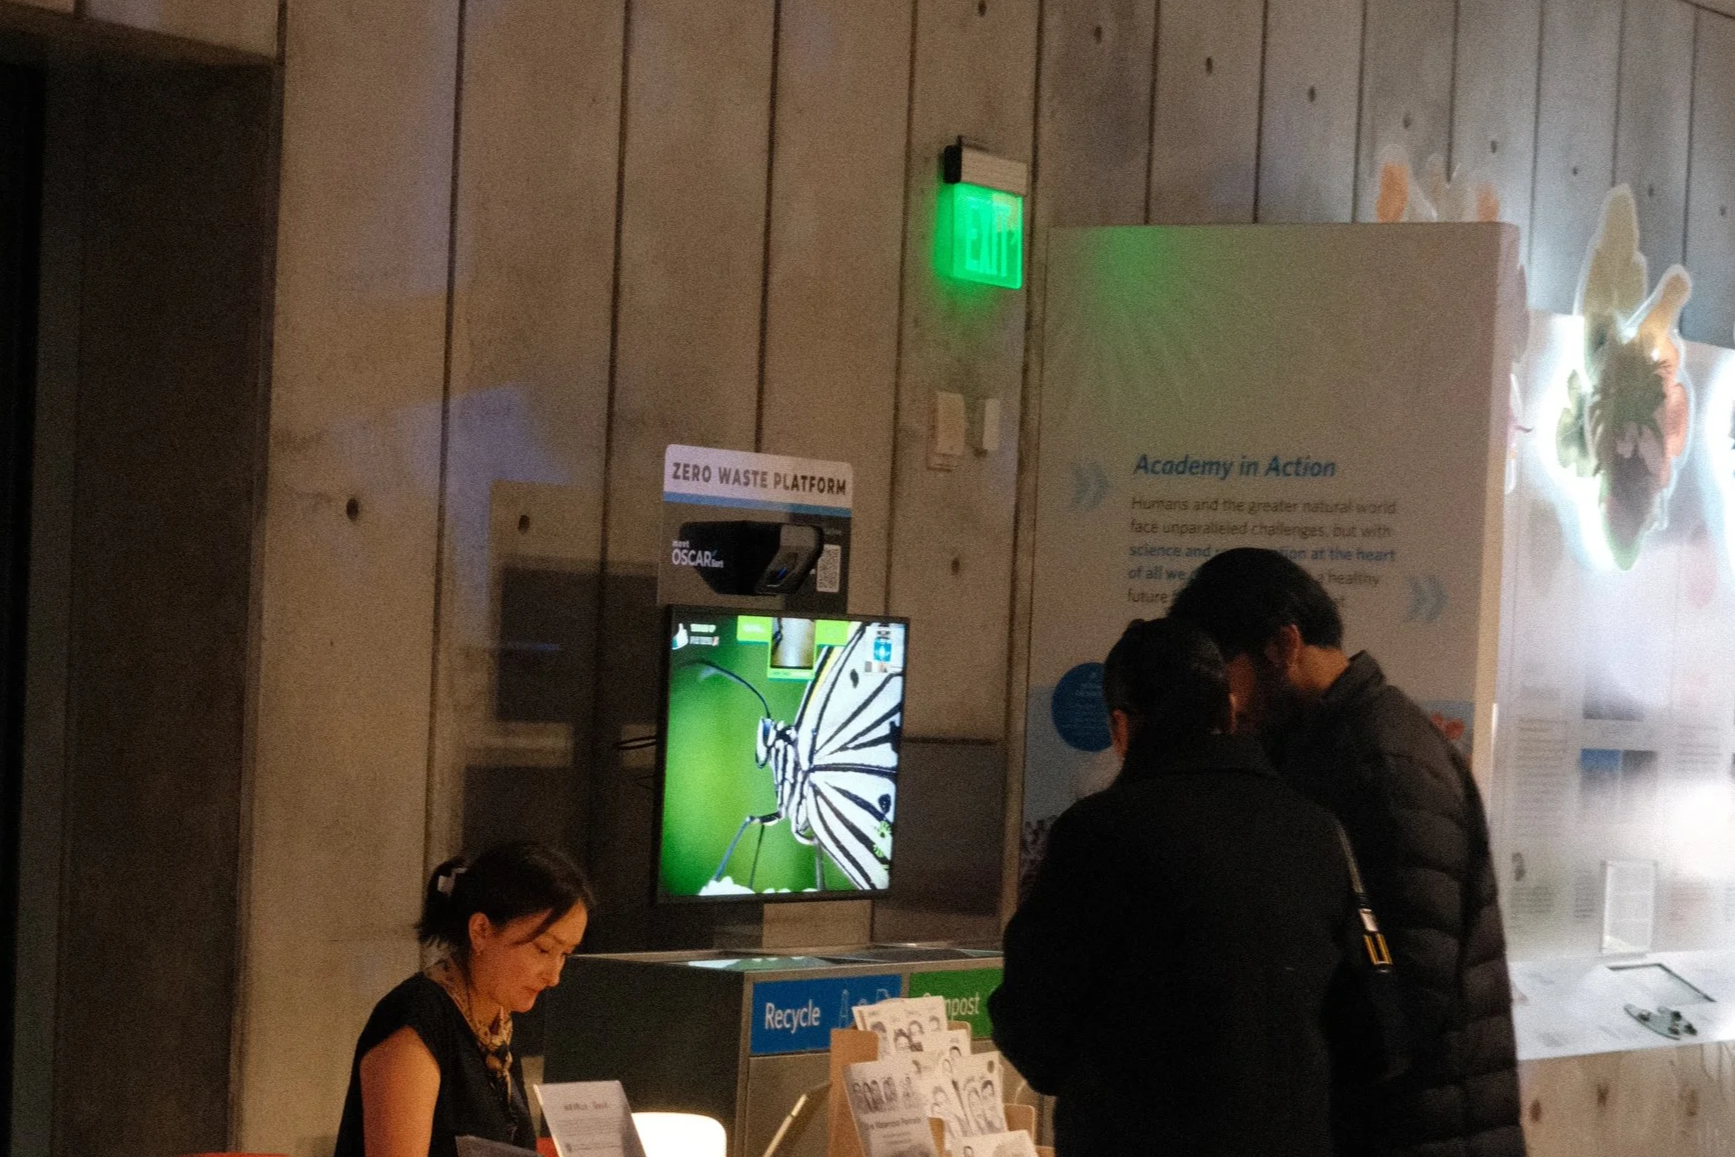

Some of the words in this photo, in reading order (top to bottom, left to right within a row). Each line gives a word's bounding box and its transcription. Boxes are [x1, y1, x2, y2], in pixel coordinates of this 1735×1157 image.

[1134, 454, 1234, 480] Academy
[1239, 456, 1259, 476] in
[1264, 456, 1336, 478] Action
[672, 462, 712, 483] ZERO
[718, 467, 768, 489] WASTE
[773, 472, 847, 496] PLATFORM
[1131, 498, 1189, 512] Humans
[1193, 499, 1218, 512] and
[1222, 499, 1243, 512] the
[1247, 500, 1298, 515] greater
[1302, 500, 1353, 514] natural
[1356, 501, 1397, 515] world
[1130, 519, 1158, 533] face
[1163, 520, 1248, 536] unparalleled
[1332, 523, 1358, 537] but
[1361, 525, 1392, 538] with
[672, 548, 712, 567] OSCAR
[1129, 544, 1181, 557] science
[1185, 545, 1211, 557] and
[1311, 549, 1325, 560] at
[1329, 548, 1353, 560] the
[1356, 549, 1396, 562] heart
[1128, 565, 1142, 579] of
[1145, 565, 1163, 579] all
[1166, 570, 1186, 580] we
[1328, 571, 1380, 587] healthy
[1128, 588, 1168, 603] future
[765, 1000, 820, 1034] Recycle
